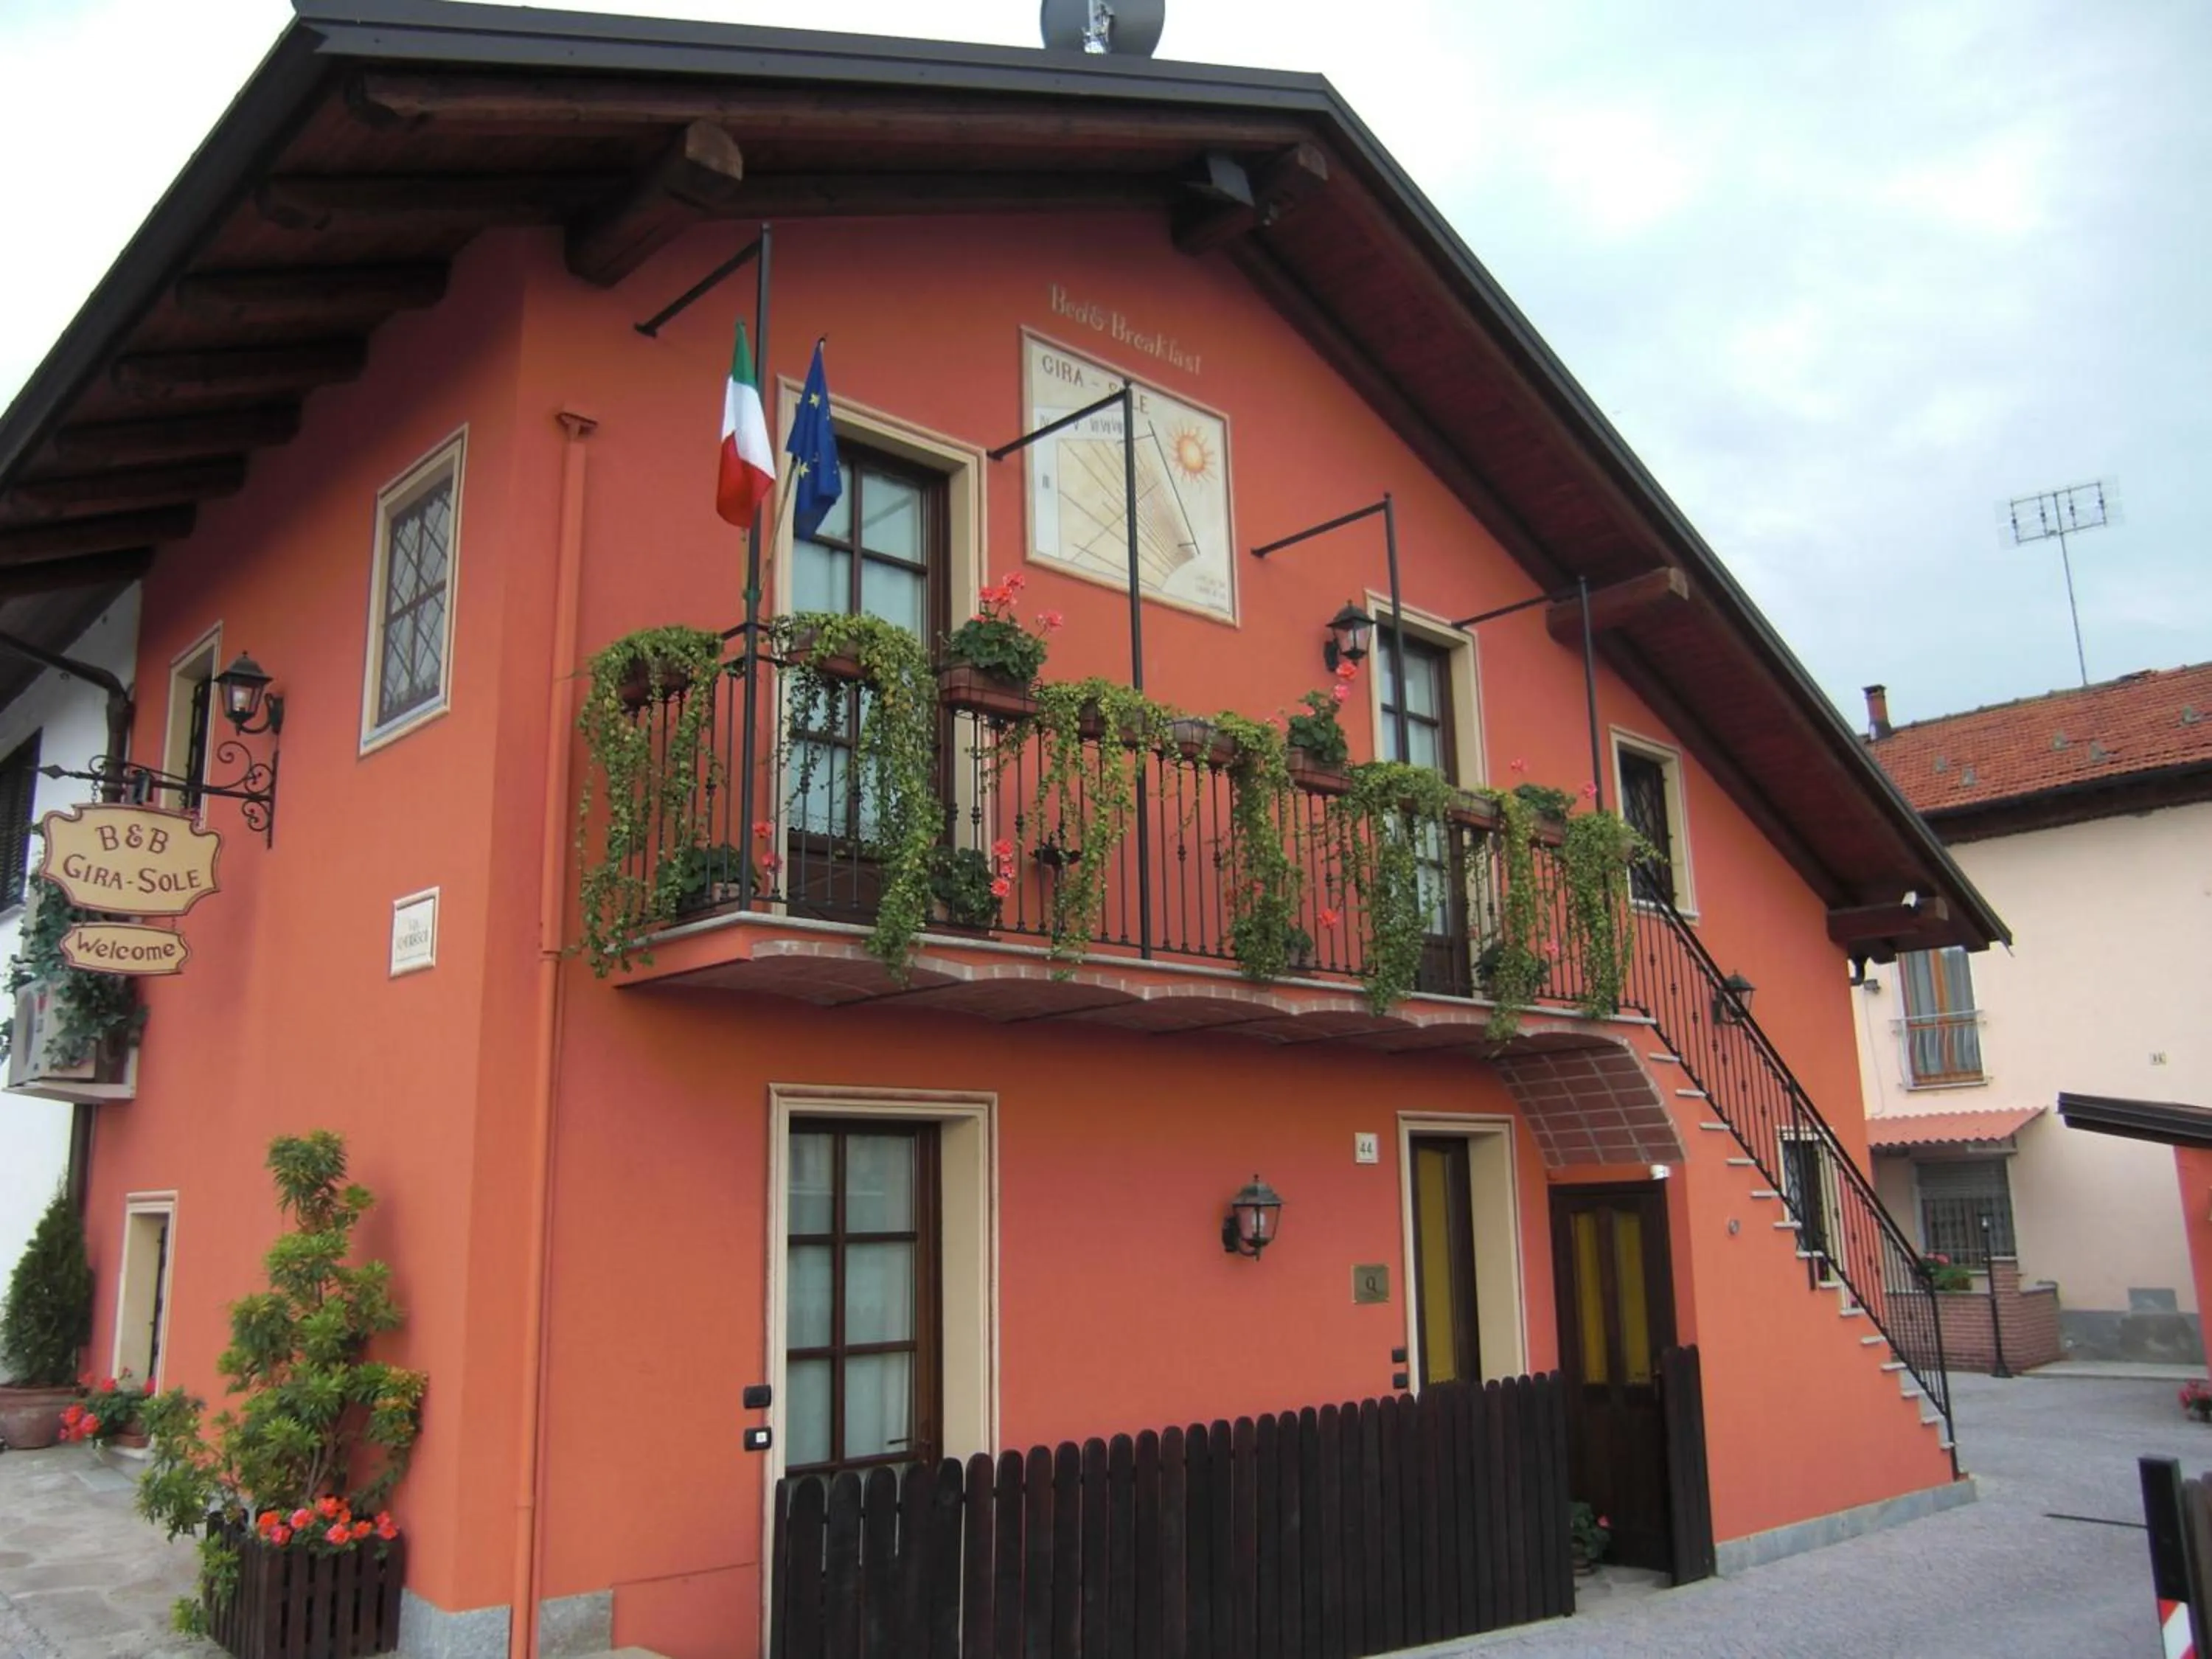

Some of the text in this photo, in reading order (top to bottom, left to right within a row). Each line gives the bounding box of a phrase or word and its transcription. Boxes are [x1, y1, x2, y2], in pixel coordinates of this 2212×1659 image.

[1042, 355, 1083, 388] GIRA
[1108, 382, 1150, 415] SE
[95, 823, 170, 855] B&B
[77, 931, 176, 961] Welcome
